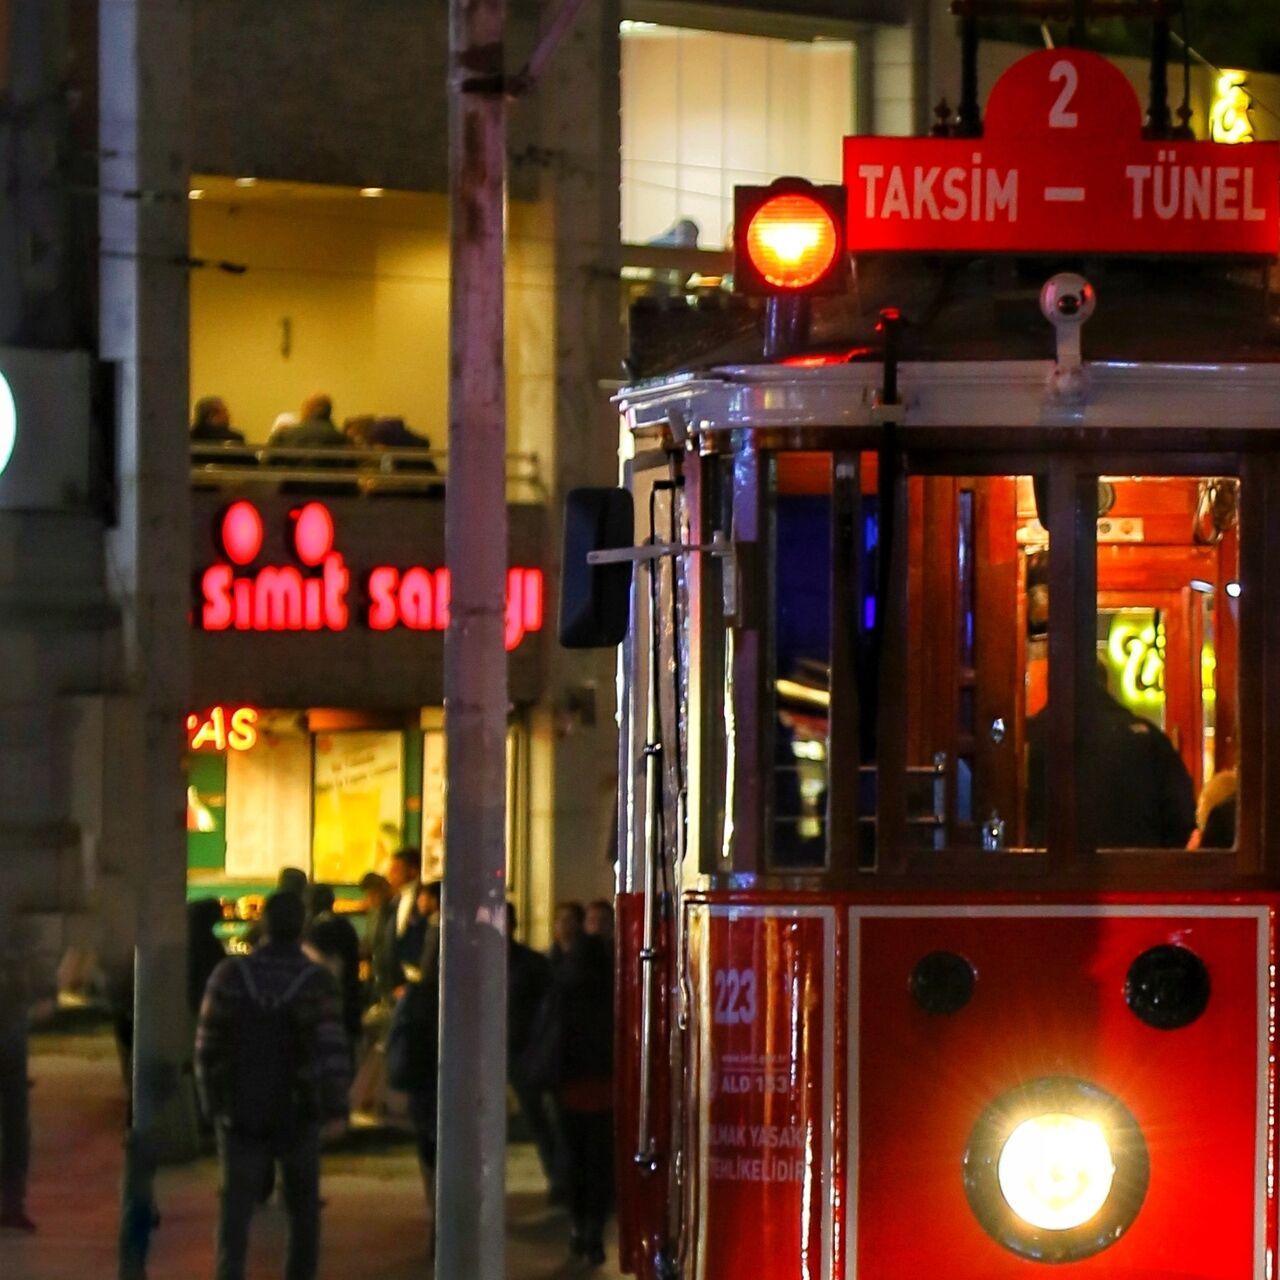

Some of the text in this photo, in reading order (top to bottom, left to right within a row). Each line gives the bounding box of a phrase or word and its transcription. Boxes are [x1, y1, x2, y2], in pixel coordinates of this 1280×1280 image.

[1048, 59, 1079, 129] 2
[858, 152, 1018, 223] TAKSİM
[1125, 149, 1266, 222] TÜNEL
[186, 706, 258, 752] AS
[714, 967, 756, 1025] 223
[721, 1074, 751, 1094] ALO
